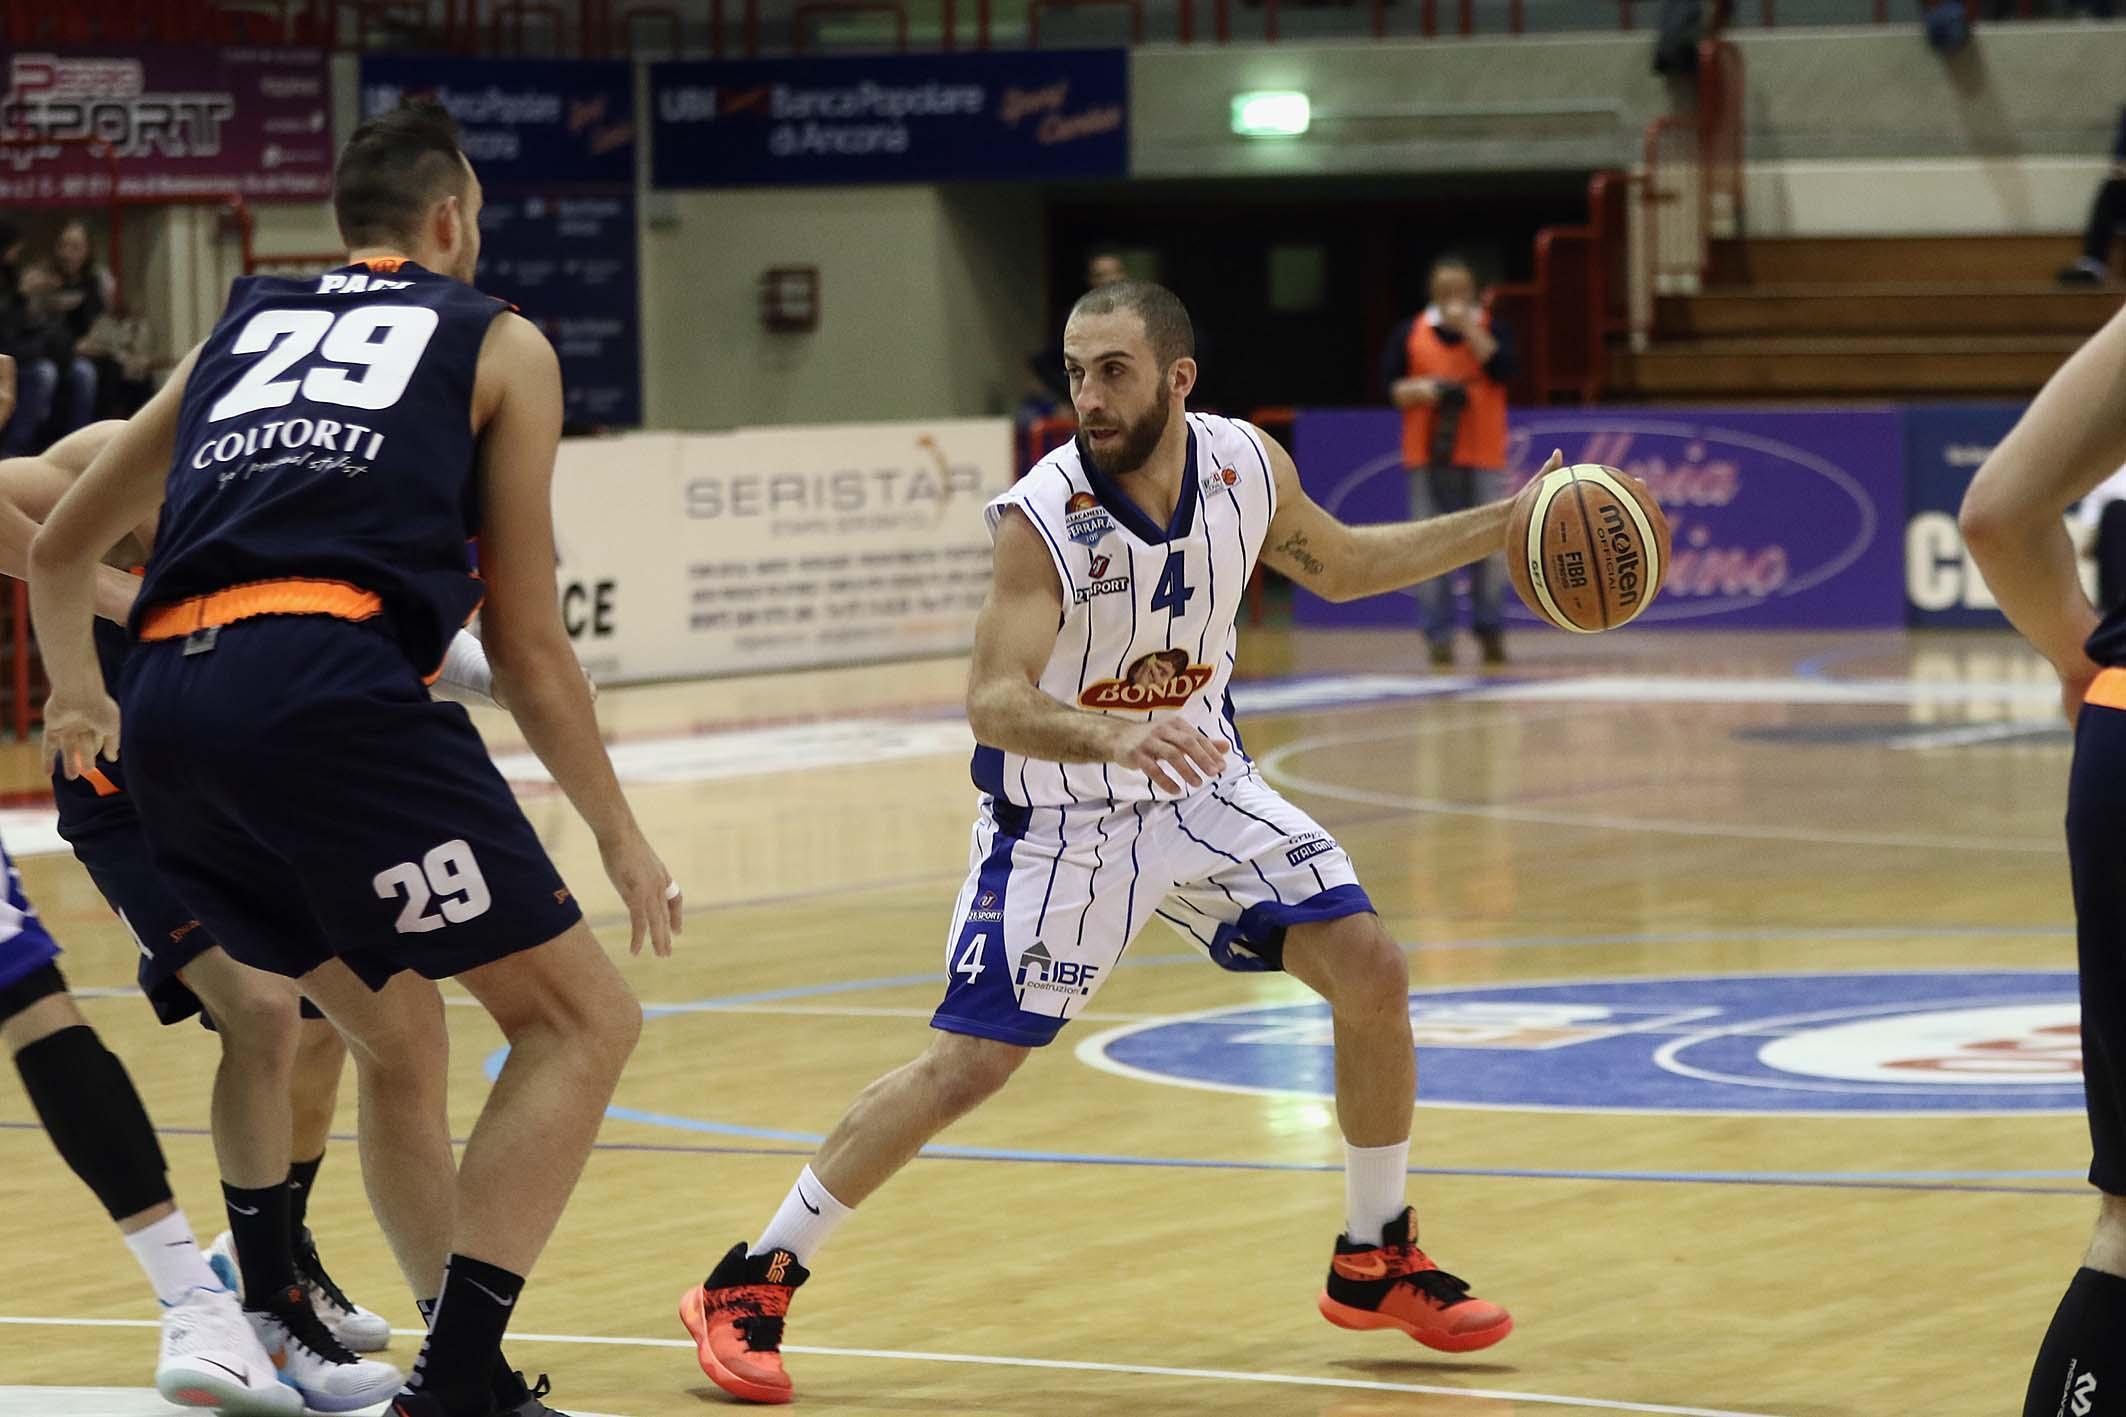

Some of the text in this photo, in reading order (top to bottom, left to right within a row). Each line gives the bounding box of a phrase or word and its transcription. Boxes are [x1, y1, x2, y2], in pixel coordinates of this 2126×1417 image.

[208, 305, 439, 424] 29
[192, 418, 385, 470] COLTORTI
[685, 466, 983, 520] SERISTAR
[1565, 551, 1588, 588] FIBA
[1597, 528, 1616, 590] OFFICIAL
[1599, 504, 1640, 607] molten
[1150, 550, 1195, 618] 4
[373, 839, 492, 934] 29
[956, 933, 987, 984] 4
[1052, 961, 1099, 987] IBF
[1027, 979, 1081, 996] costruzion
